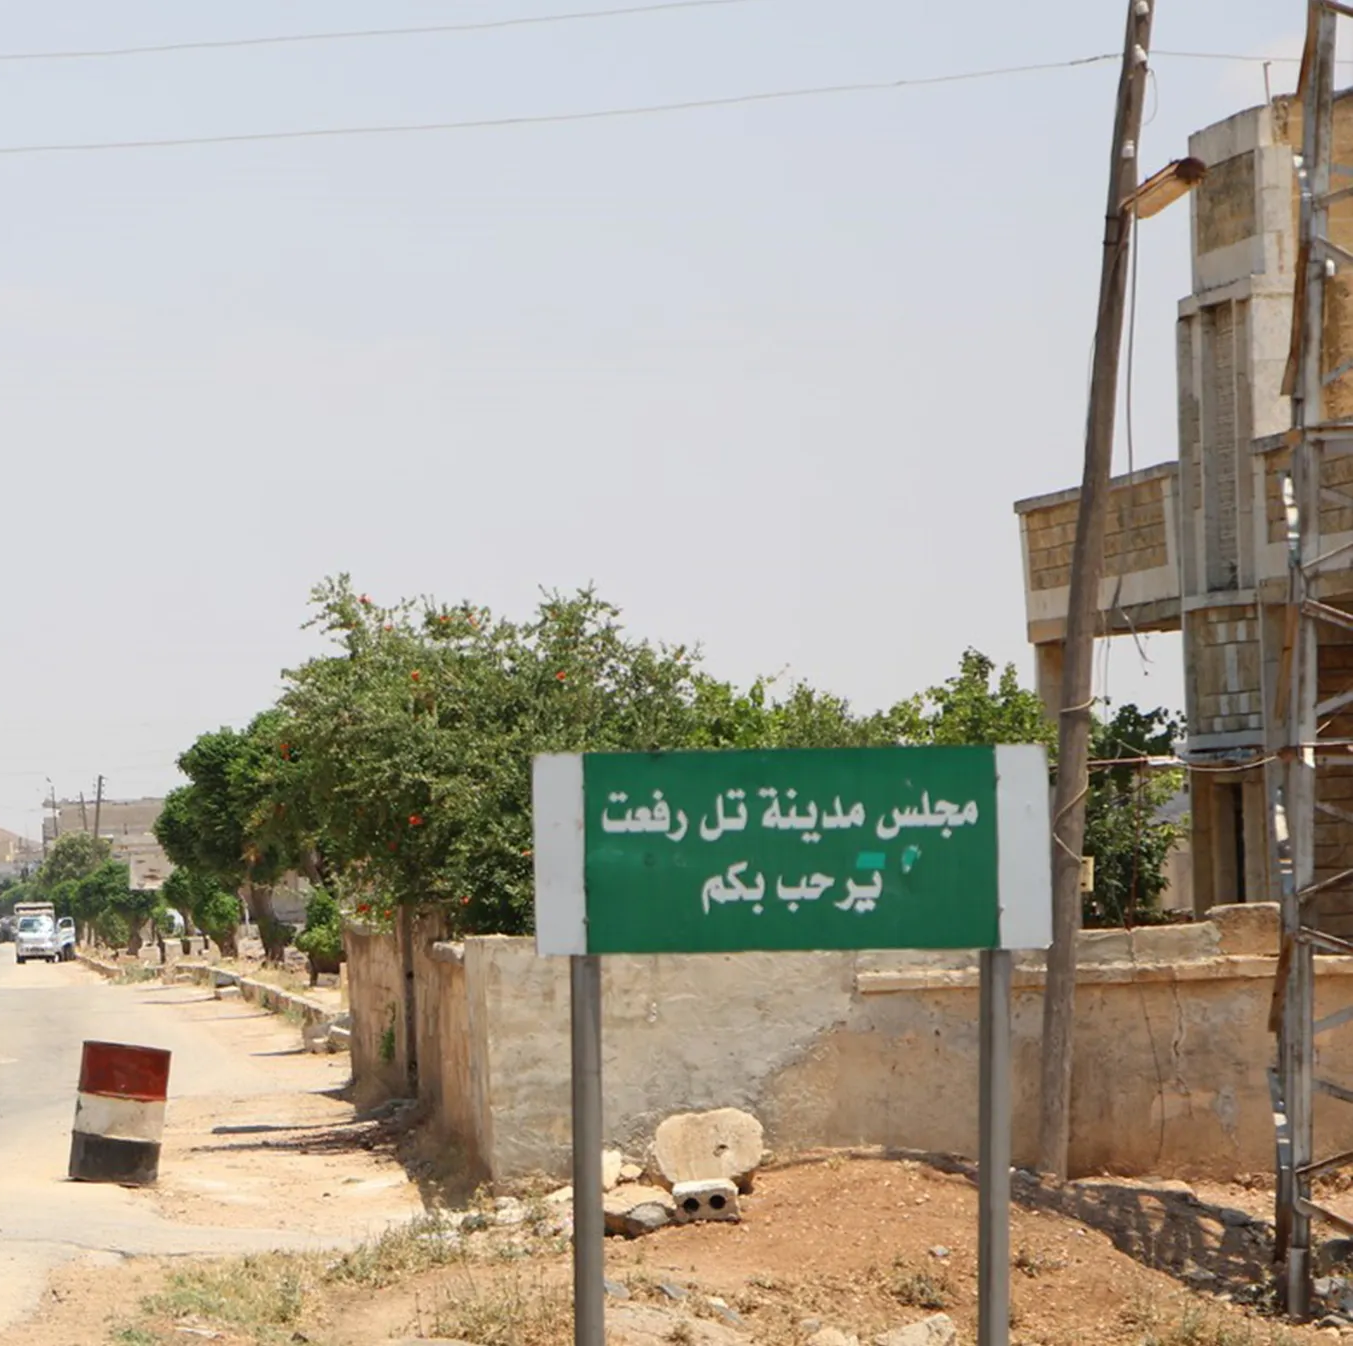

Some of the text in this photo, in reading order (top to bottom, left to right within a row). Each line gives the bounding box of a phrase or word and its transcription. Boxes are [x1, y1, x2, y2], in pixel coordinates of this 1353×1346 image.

[602, 788, 978, 842] مجلس مدينة تل رفعت
[702, 861, 882, 913] يرحب بكم
